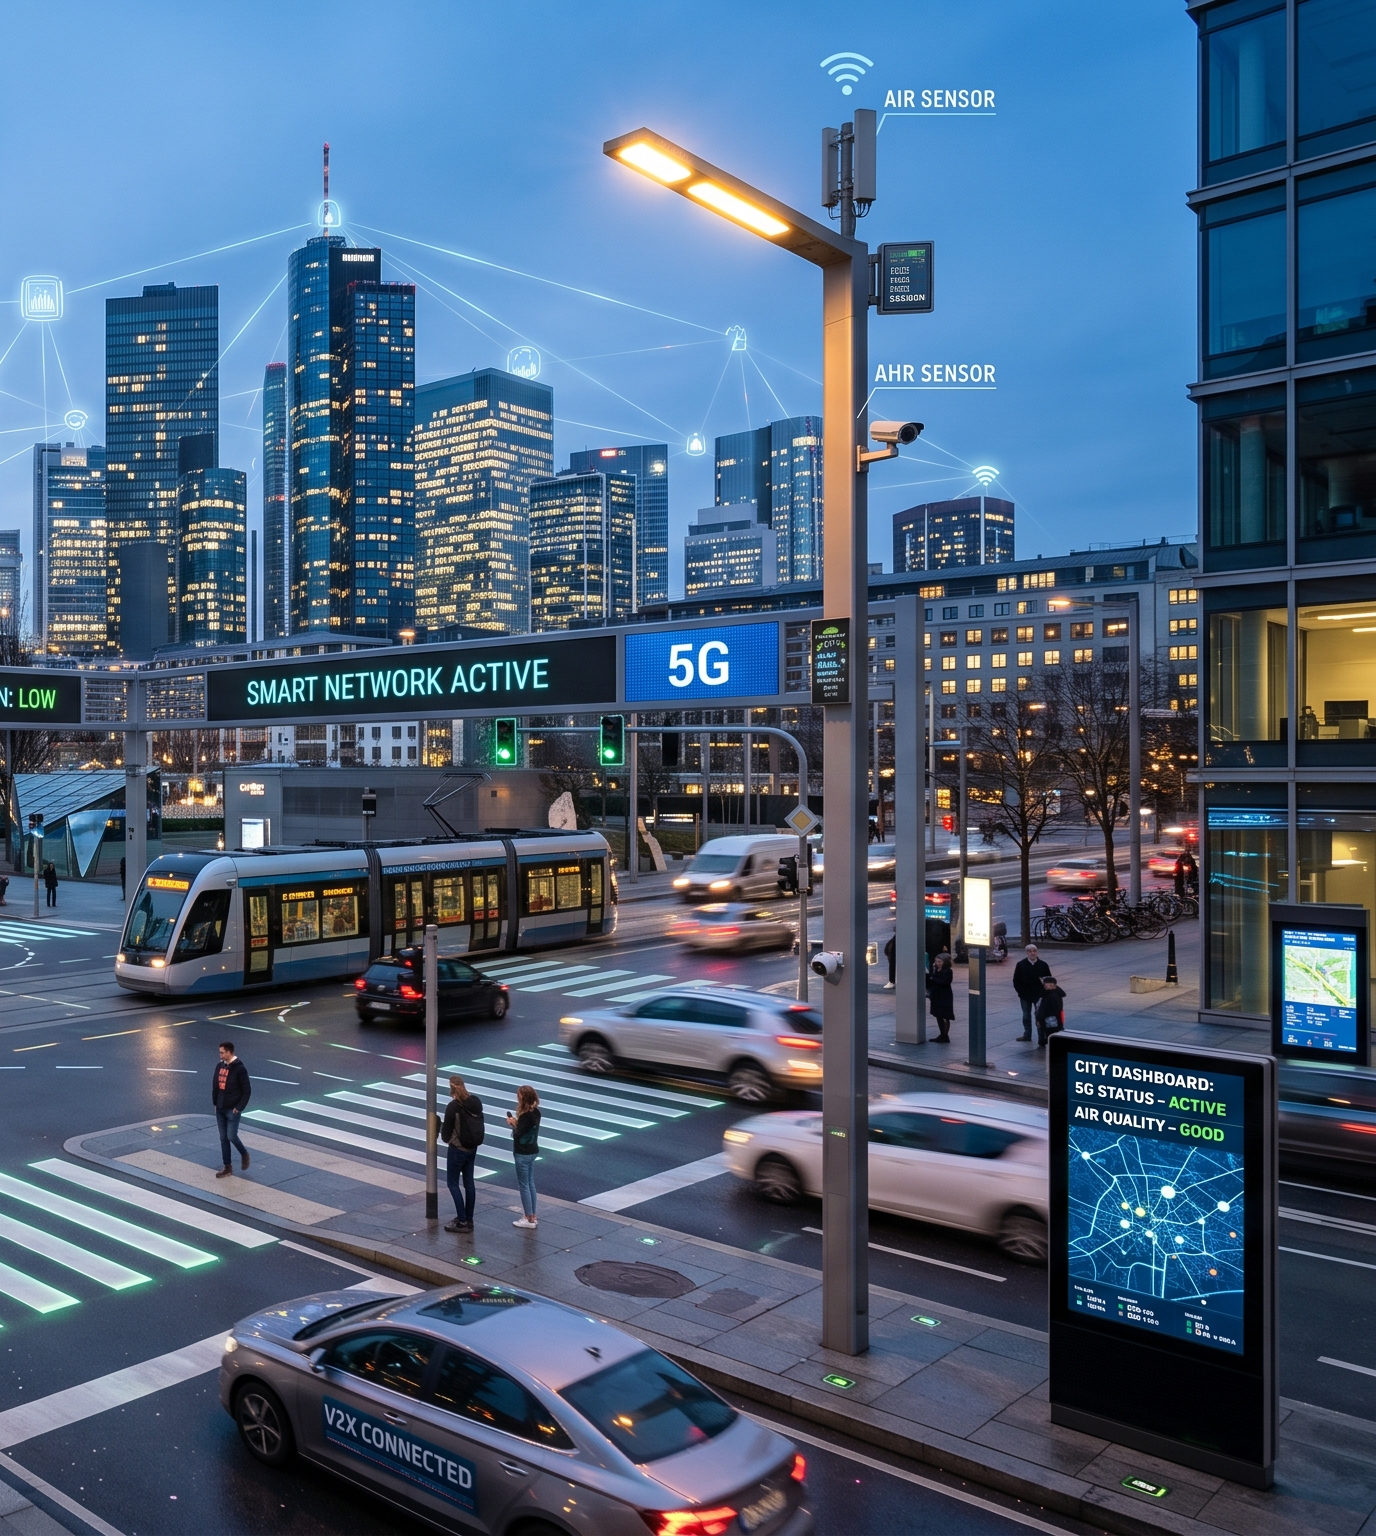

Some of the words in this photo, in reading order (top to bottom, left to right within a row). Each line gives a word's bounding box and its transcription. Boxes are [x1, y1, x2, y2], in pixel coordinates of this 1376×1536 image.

[247, 676, 318, 705] SMART
[325, 666, 443, 701] NETWORK
[450, 658, 549, 694] ACTIVE
[668, 640, 729, 688] 5G
[19, 688, 56, 709] LOW
[1075, 1060, 1108, 1076] CITY
[1112, 1065, 1214, 1092] DASHBOARD:
[1075, 1081, 1094, 1095] 5G
[1098, 1084, 1155, 1105] STATUS
[1169, 1096, 1227, 1116] ACTIVE
[1074, 1106, 1099, 1121] AIR
[1102, 1110, 1165, 1132] QUALITY
[1179, 1123, 1225, 1142] GOOD
[324, 1403, 358, 1438] V2X
[361, 1422, 472, 1489] CONNECTED
